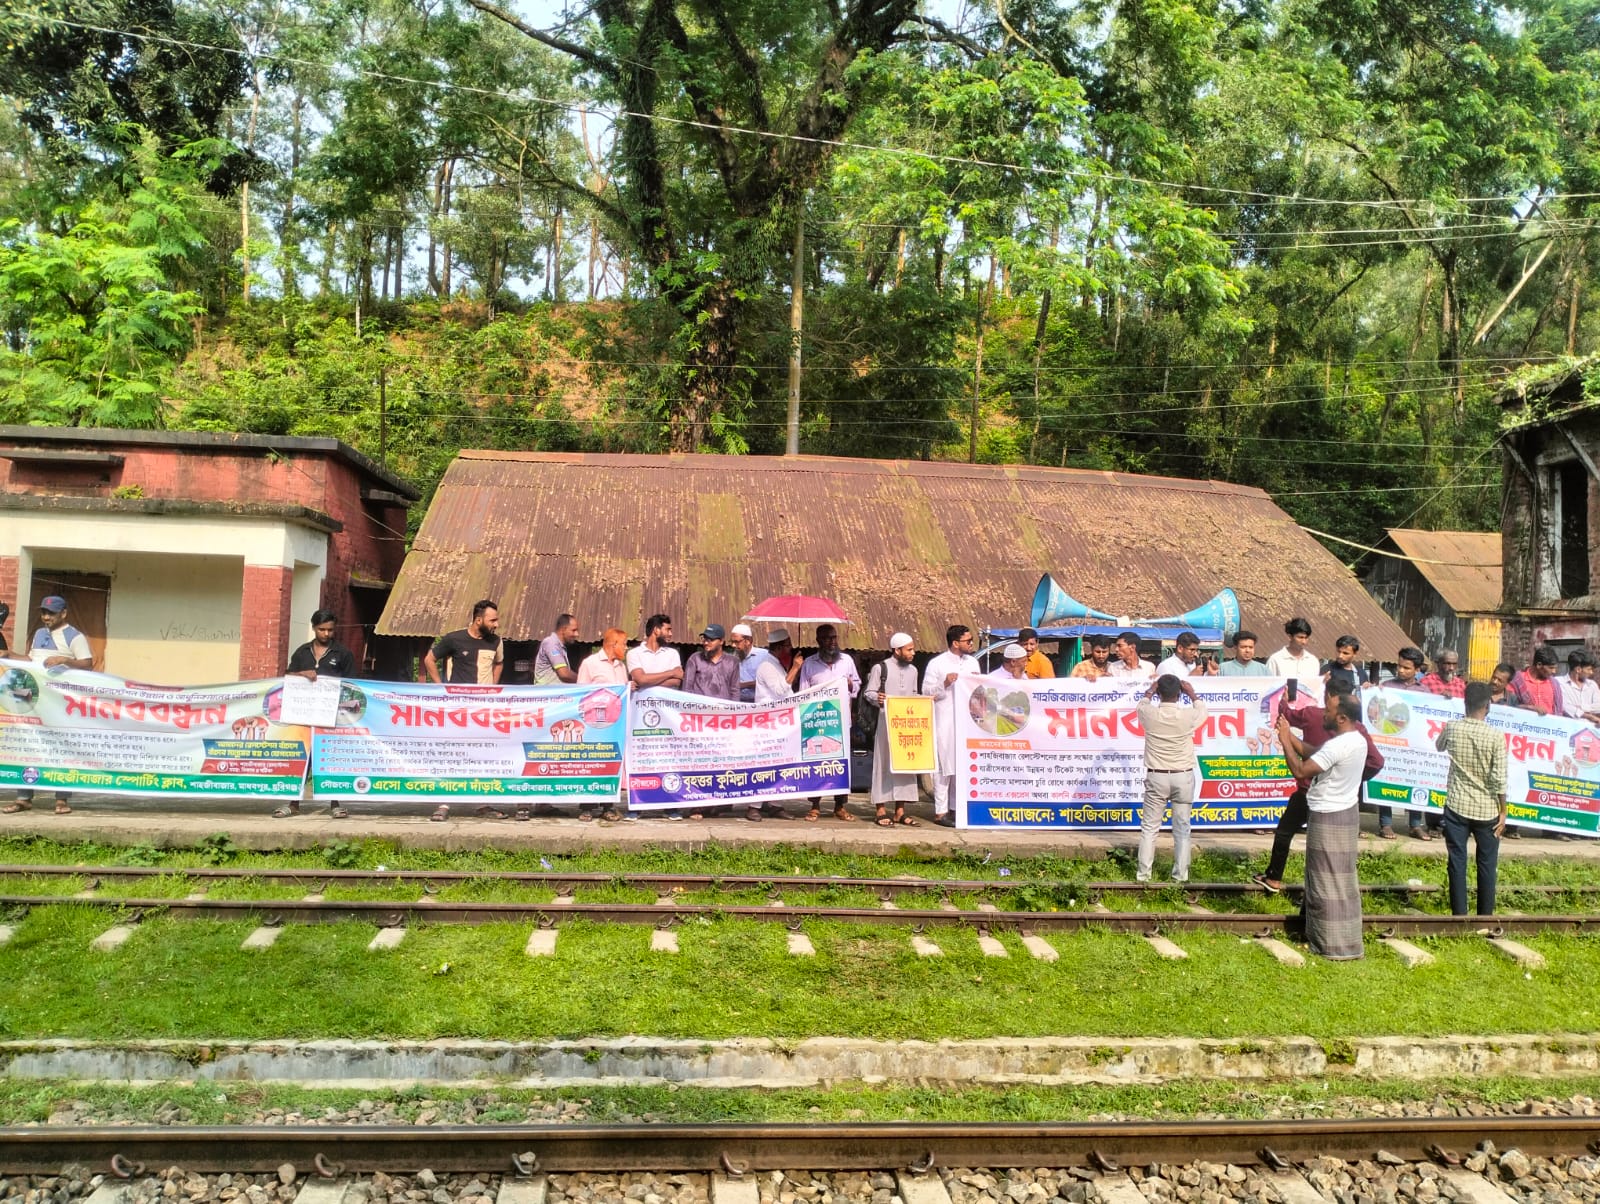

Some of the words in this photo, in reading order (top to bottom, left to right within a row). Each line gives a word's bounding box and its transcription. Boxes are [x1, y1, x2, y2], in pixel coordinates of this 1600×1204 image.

[1033, 688, 1086, 702] শাহজিবাজার
[1088, 690, 1131, 702] রেলস্টেশ
[1232, 689, 1259, 702] দাবিতে
[64, 694, 227, 729] মানববন্ধন
[390, 704, 545, 733] মানববন্ধন
[979, 751, 1016, 761] শাহজিবাজার
[1018, 752, 1058, 761] রেলস্টেশনের
[1253, 758, 1287, 768] রেলস্টেশ
[43, 768, 113, 785] শাহজীবাজার
[115, 771, 160, 788] স্পোর্টিং
[161, 776, 187, 790] ক্লাব,
[405, 781, 435, 791] ওদের
[439, 780, 466, 792] পাশে
[470, 778, 505, 793] দাঁড়াই,
[507, 782, 554, 793] শাহজীবাজার,
[682, 774, 713, 793] বৃহত্তর
[715, 770, 748, 790] কুমিল্লা
[751, 770, 776, 784] জেলা
[779, 764, 811, 780] কল্যাণ
[812, 760, 846, 778] সমিতি
[988, 807, 1055, 823] আয়োজনে:
[1059, 804, 1132, 823] শাহজিবাজার
[1190, 803, 1238, 823] সর্বস্তরের
